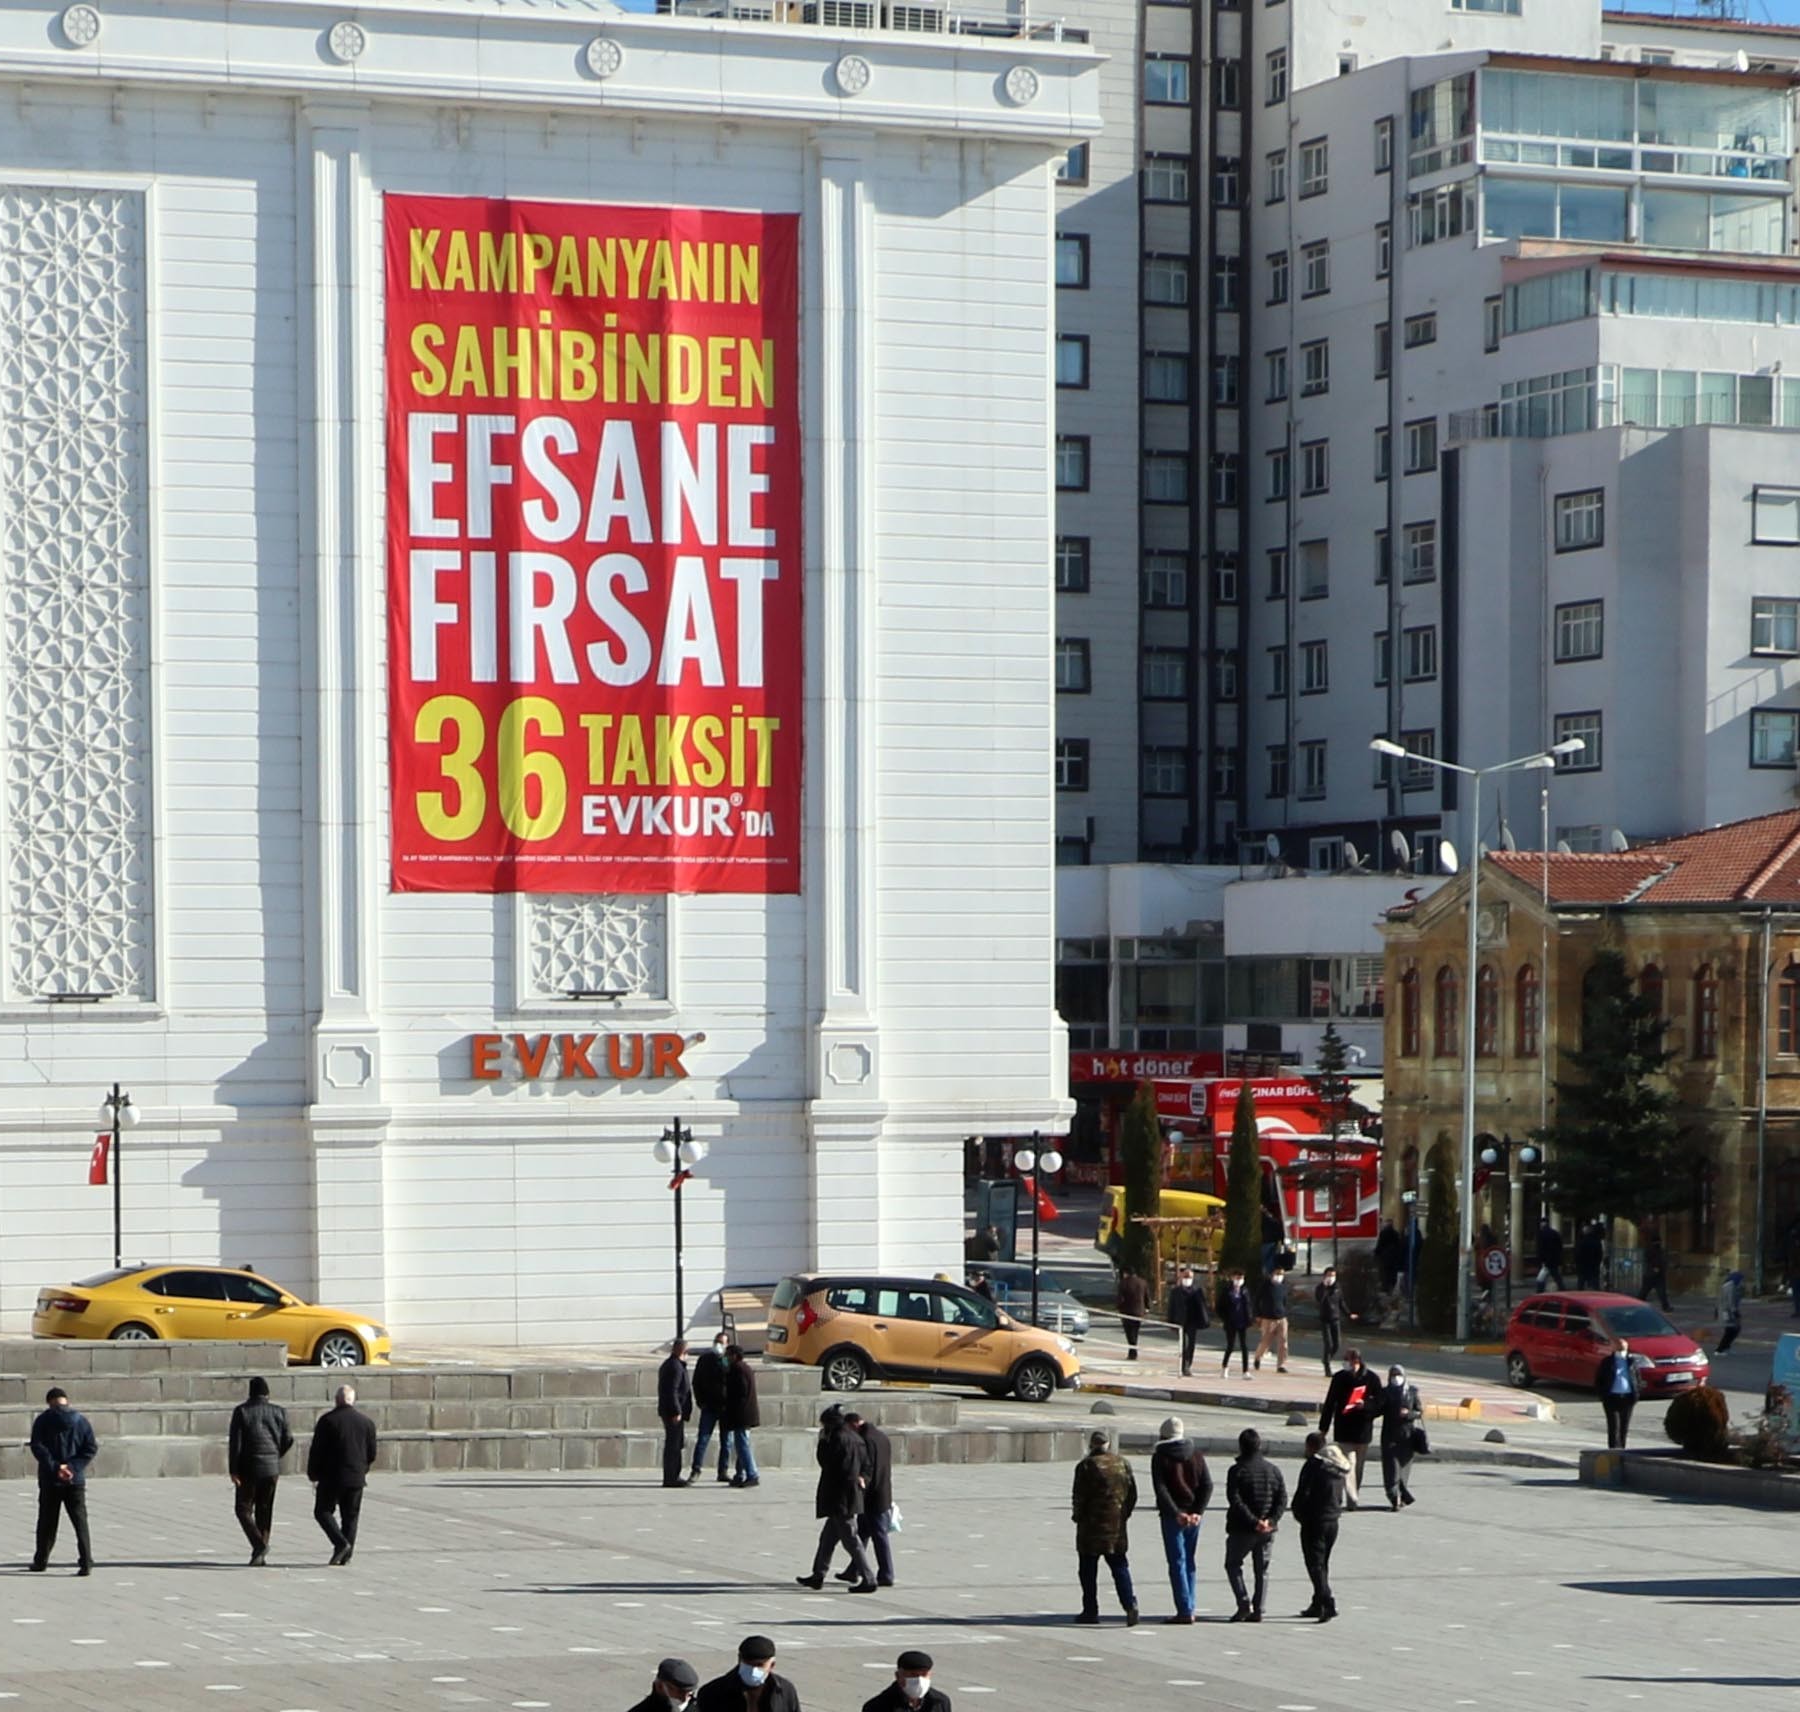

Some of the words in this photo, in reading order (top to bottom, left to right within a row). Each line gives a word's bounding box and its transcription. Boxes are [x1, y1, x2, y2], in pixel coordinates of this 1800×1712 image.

[409, 227, 760, 306] KAMPANYANIN
[409, 309, 775, 409] SAHİBİNDEN
[407, 412, 777, 548] EFSANE
[408, 549, 779, 689] FIRSAT
[414, 694, 568, 843] 36
[579, 704, 780, 788] TAKSİT
[1133, 1057, 1194, 1076] döner
